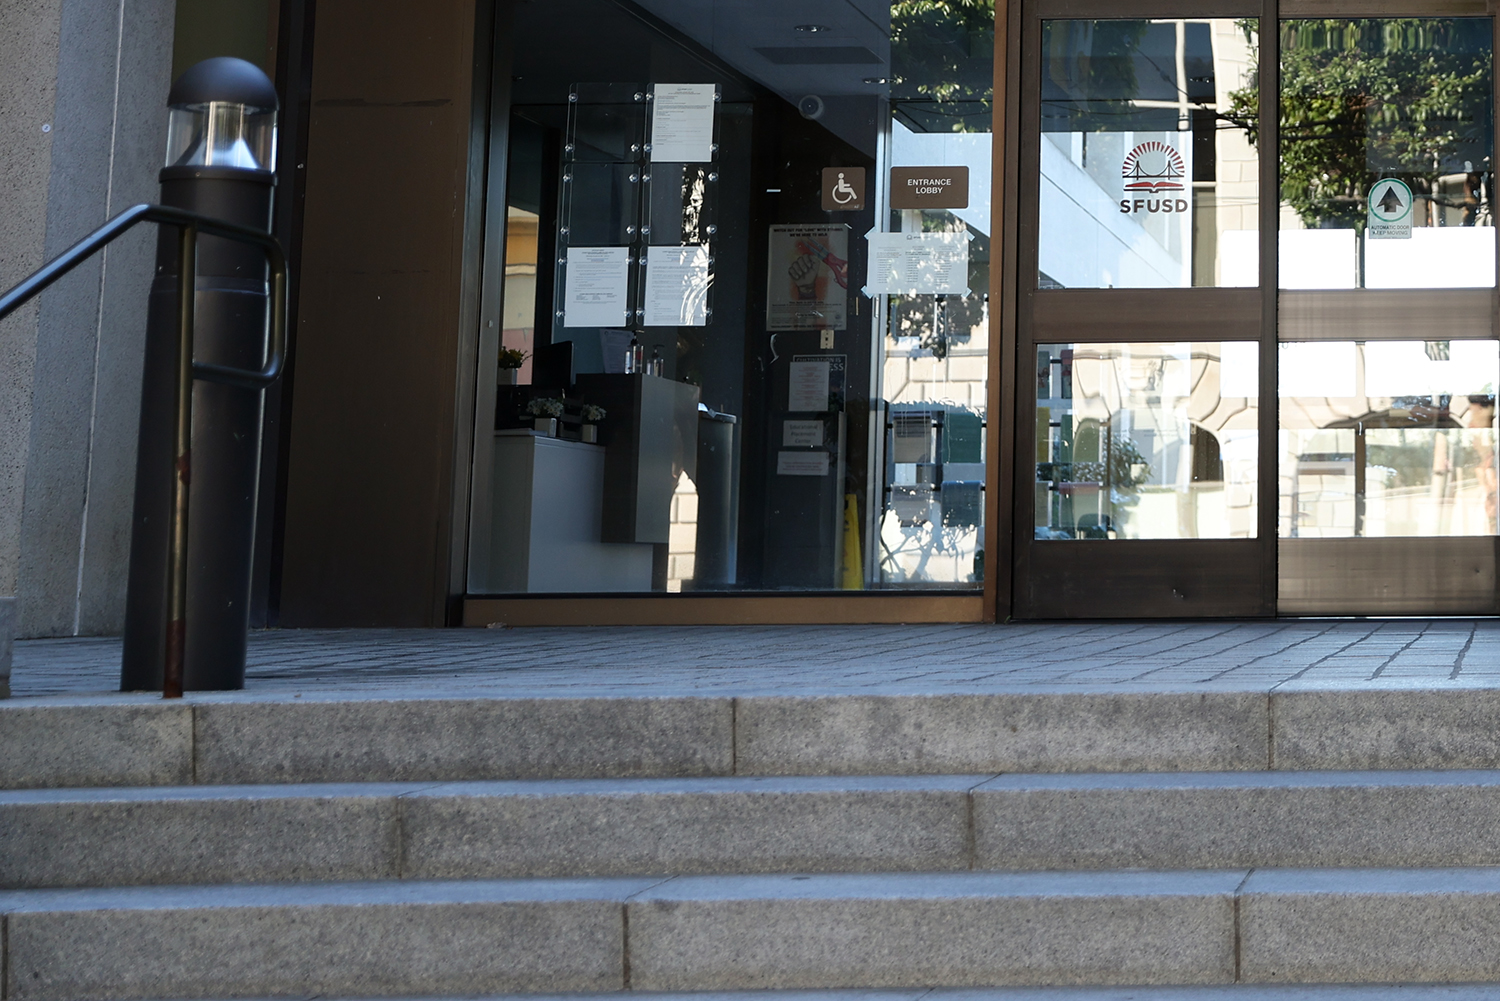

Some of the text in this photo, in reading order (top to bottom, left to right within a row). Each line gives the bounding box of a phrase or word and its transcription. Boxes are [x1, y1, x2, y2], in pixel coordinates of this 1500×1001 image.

[907, 178, 952, 186] ENTRANCE
[915, 186, 943, 194] LOBBY
[1120, 199, 1188, 214] SFUSD
